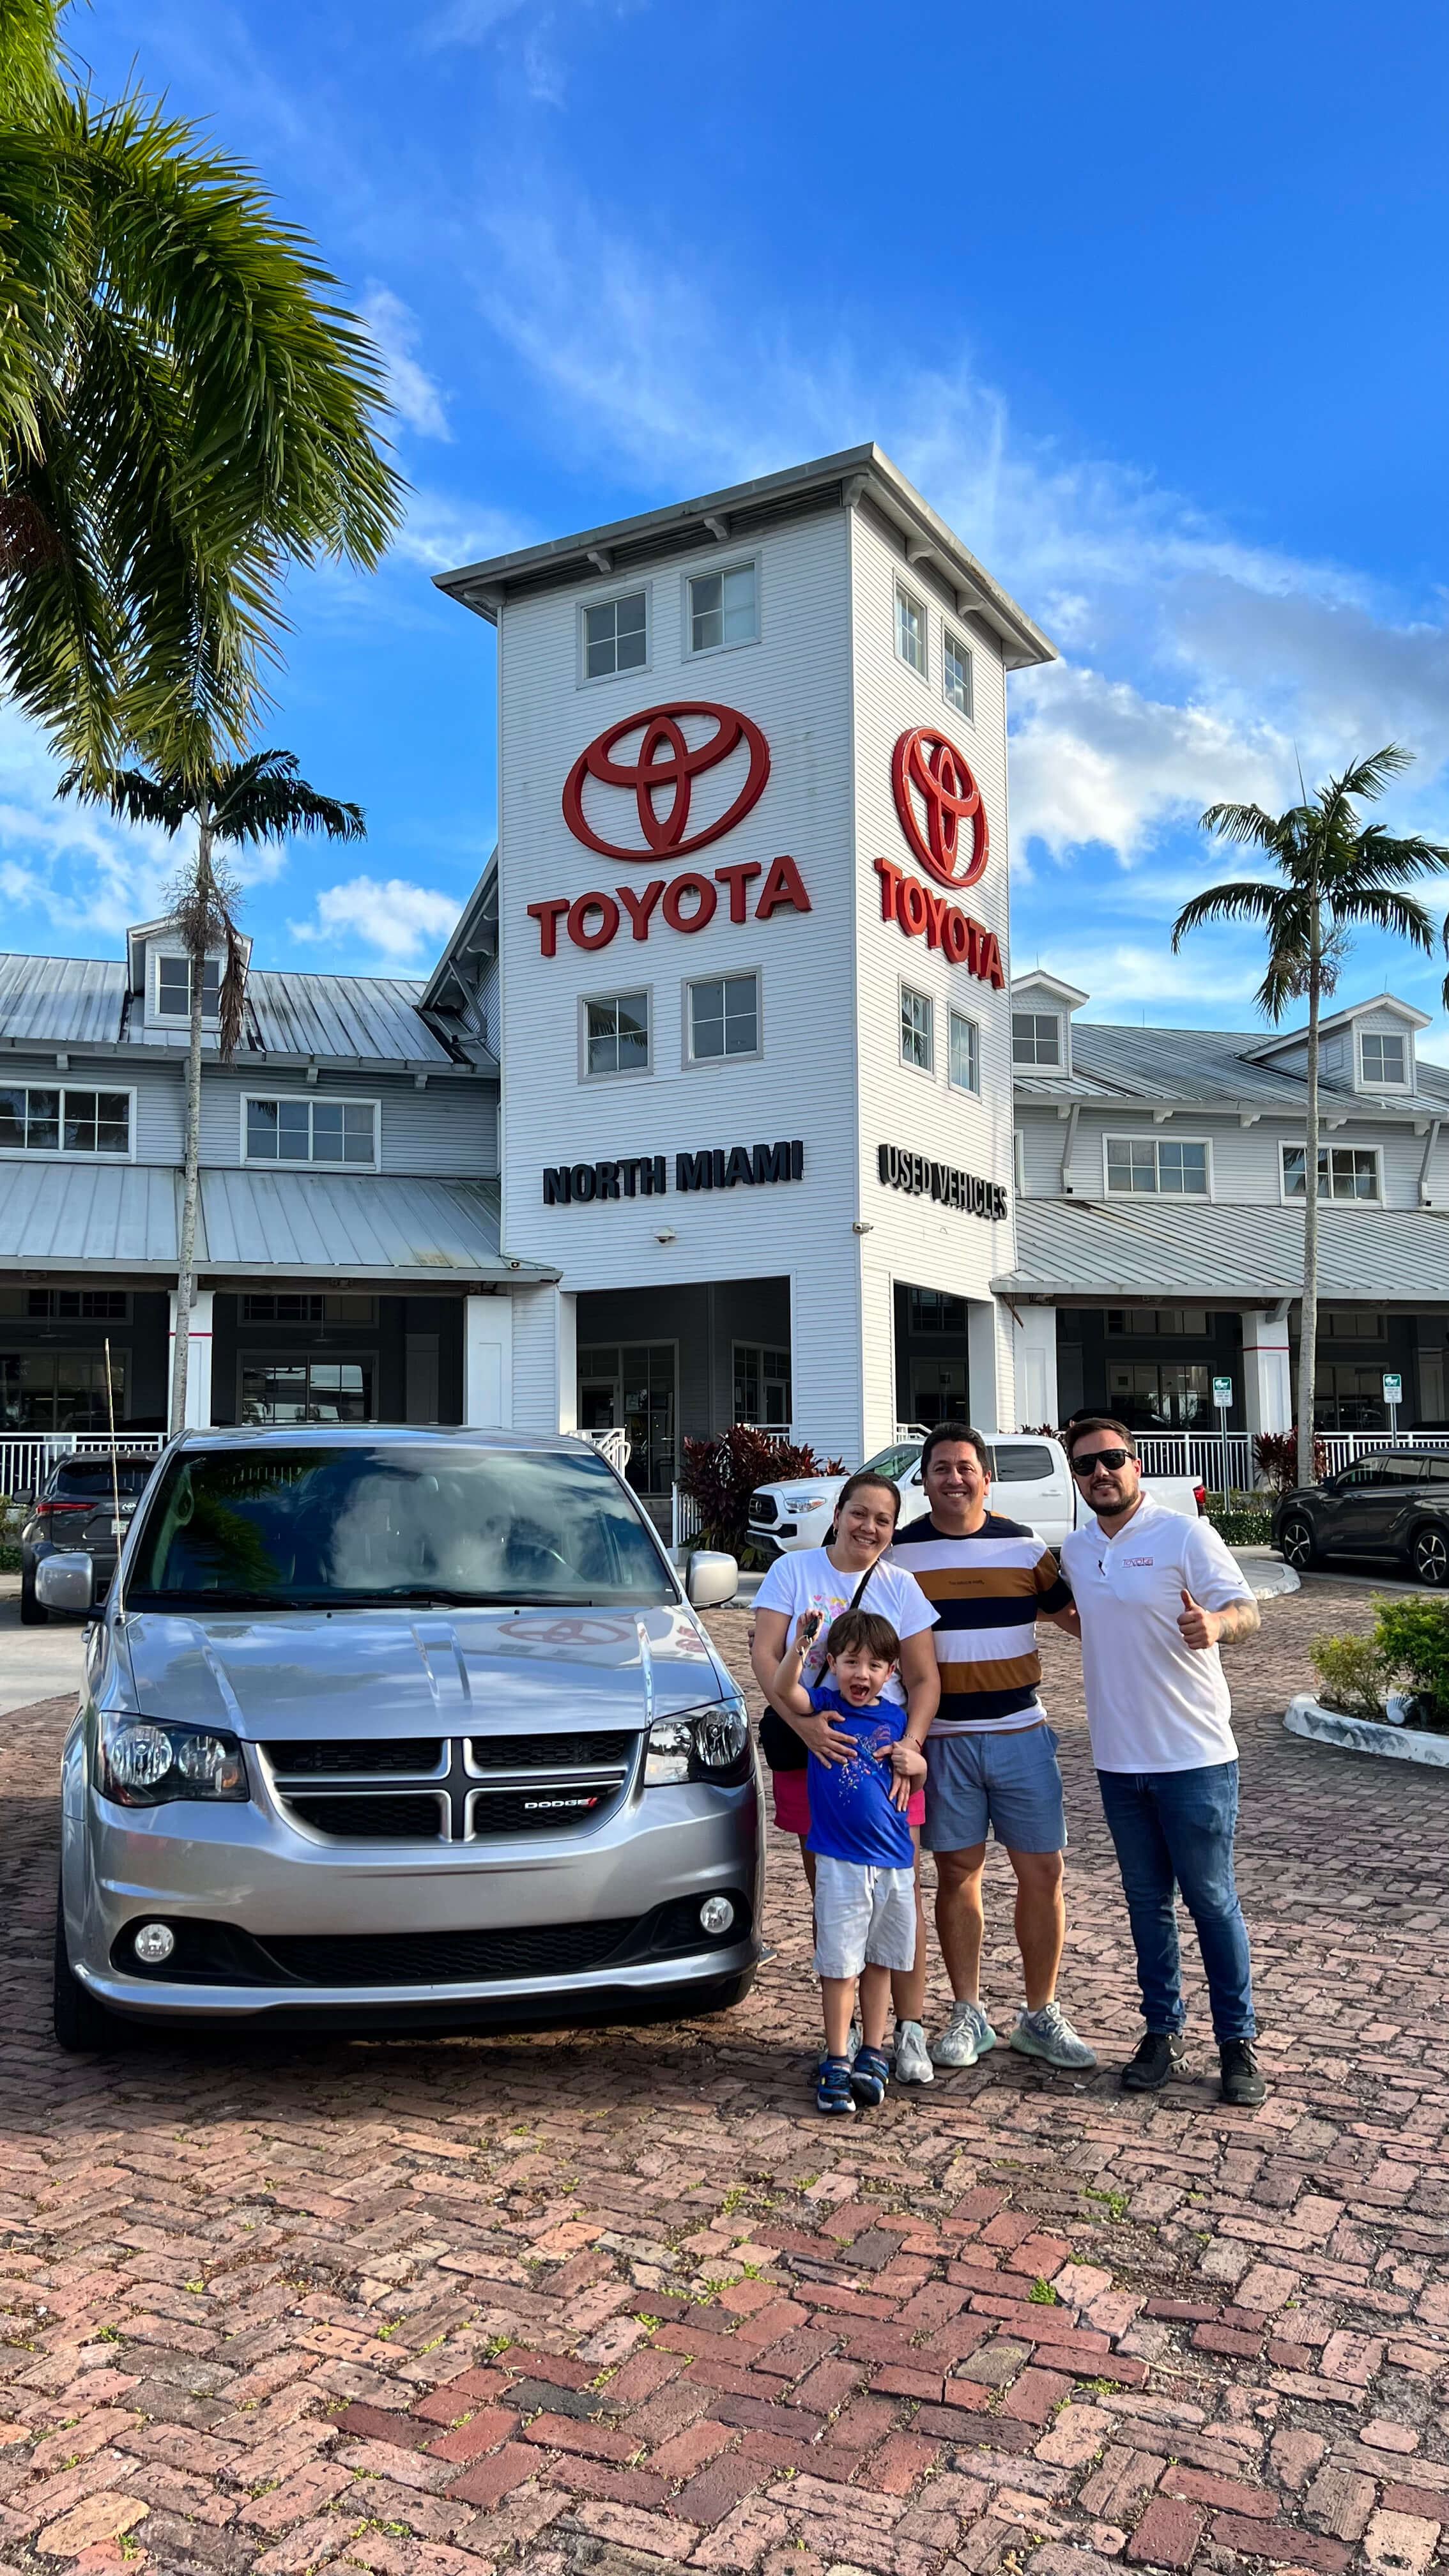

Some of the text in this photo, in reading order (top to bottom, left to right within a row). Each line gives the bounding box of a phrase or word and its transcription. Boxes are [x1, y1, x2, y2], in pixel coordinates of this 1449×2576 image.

[527, 855, 812, 956] TOYOTA
[874, 857, 1006, 989] TOYOTA
[543, 1140, 803, 1204] NORTH MIAMI
[879, 1144, 1008, 1220] USED VEHICLES
[525, 1798, 589, 1809] DODGE
